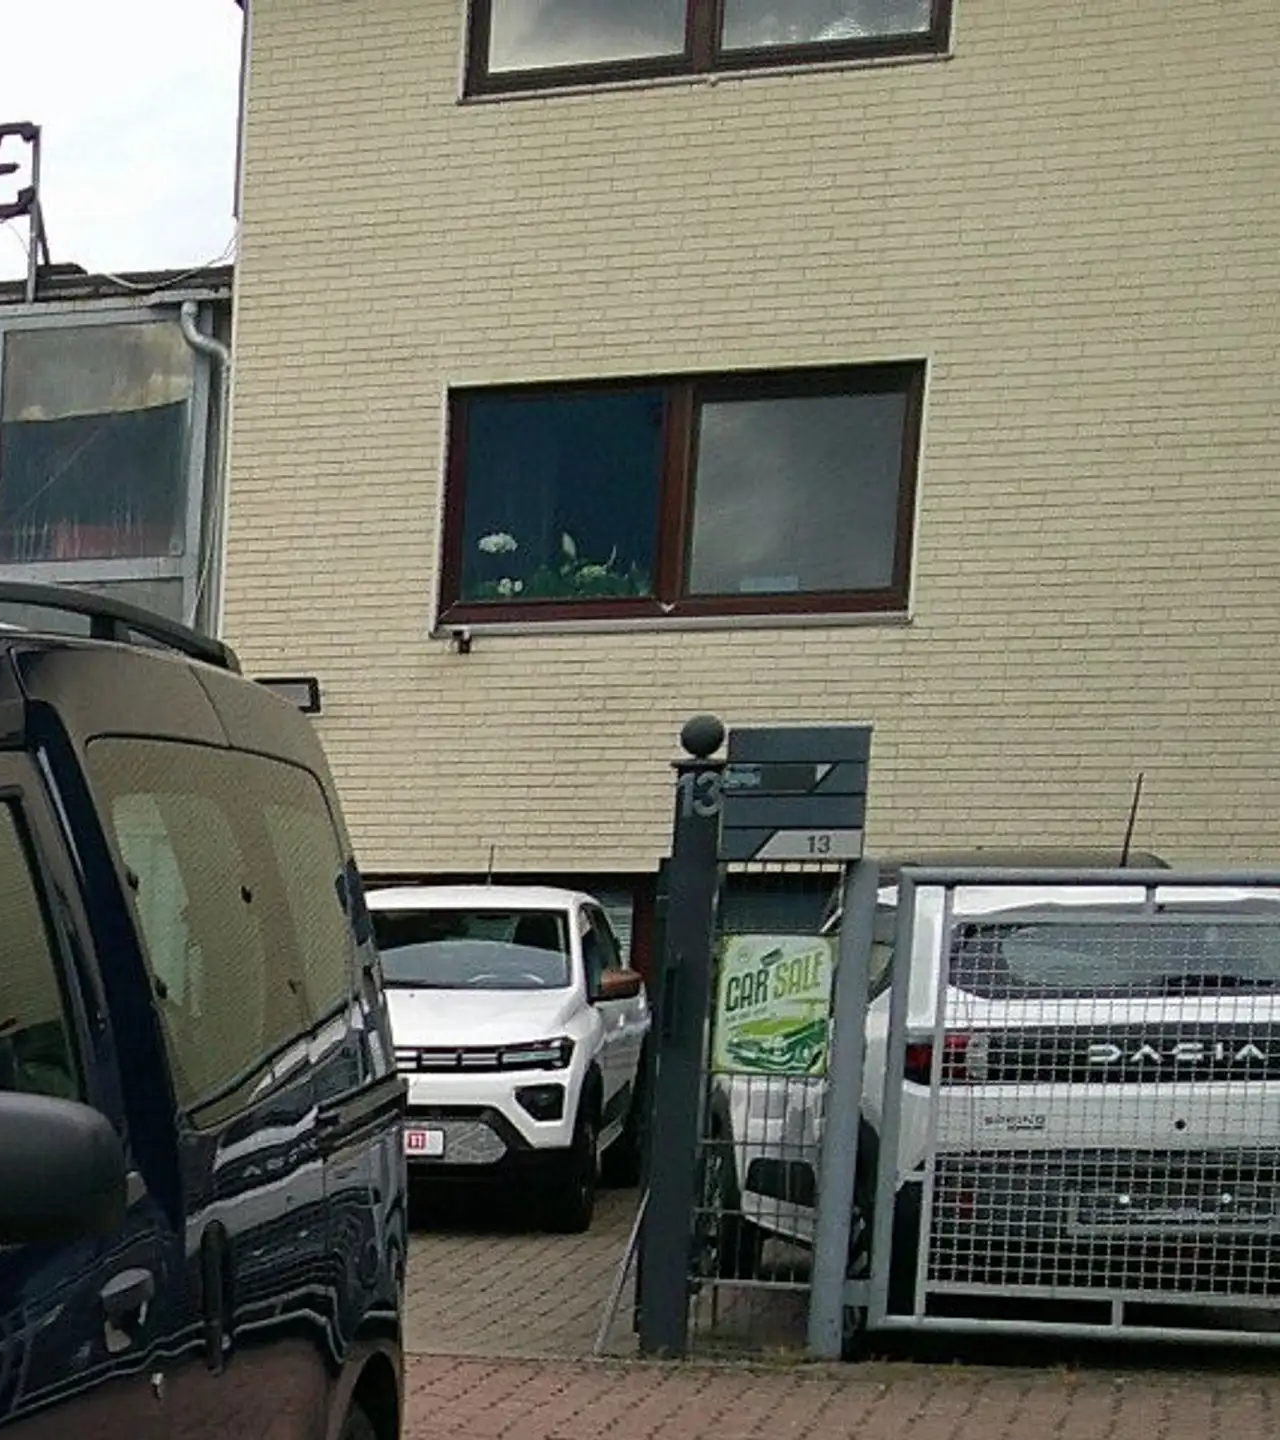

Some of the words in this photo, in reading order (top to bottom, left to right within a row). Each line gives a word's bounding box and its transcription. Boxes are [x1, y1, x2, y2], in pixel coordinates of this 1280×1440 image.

[678, 770, 722, 817] 13
[806, 835, 831, 854] 13
[725, 968, 770, 1012] CAR
[772, 950, 825, 998] SALE
[1086, 1041, 1266, 1064] DACIA
